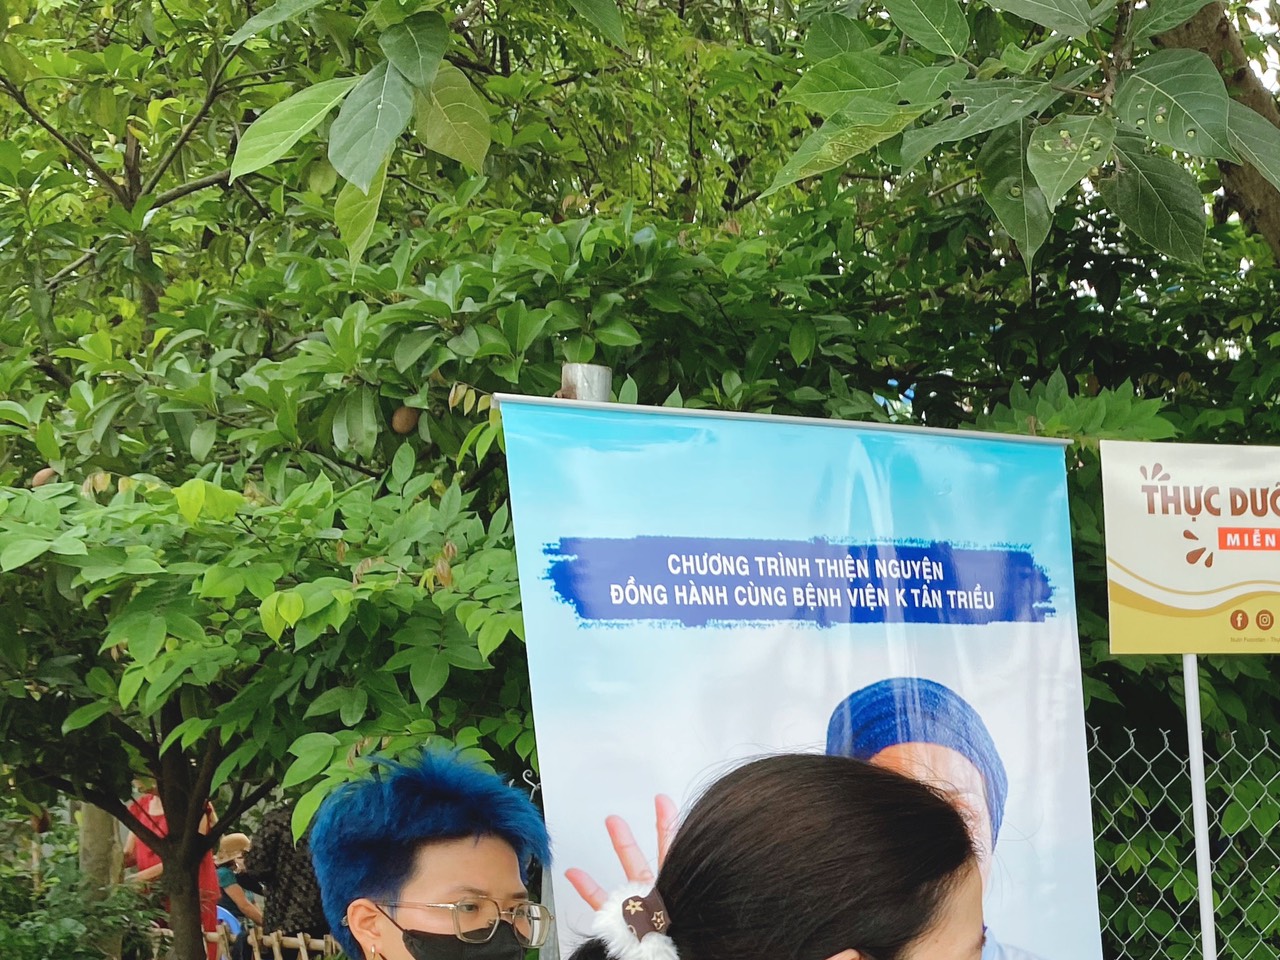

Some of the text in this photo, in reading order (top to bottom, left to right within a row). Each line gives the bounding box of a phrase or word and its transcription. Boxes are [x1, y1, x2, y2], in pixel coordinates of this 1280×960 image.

[1141, 484, 1221, 523] THỰC
[1226, 528, 1278, 549] MIỄN
[667, 551, 945, 584] CHƯƠNG TRÌNH THIỆN NGUYỆN
[610, 575, 995, 612] ĐỒNG HÀNH CÙNG BỆNH VIỆN K TÂN TRIỀU
